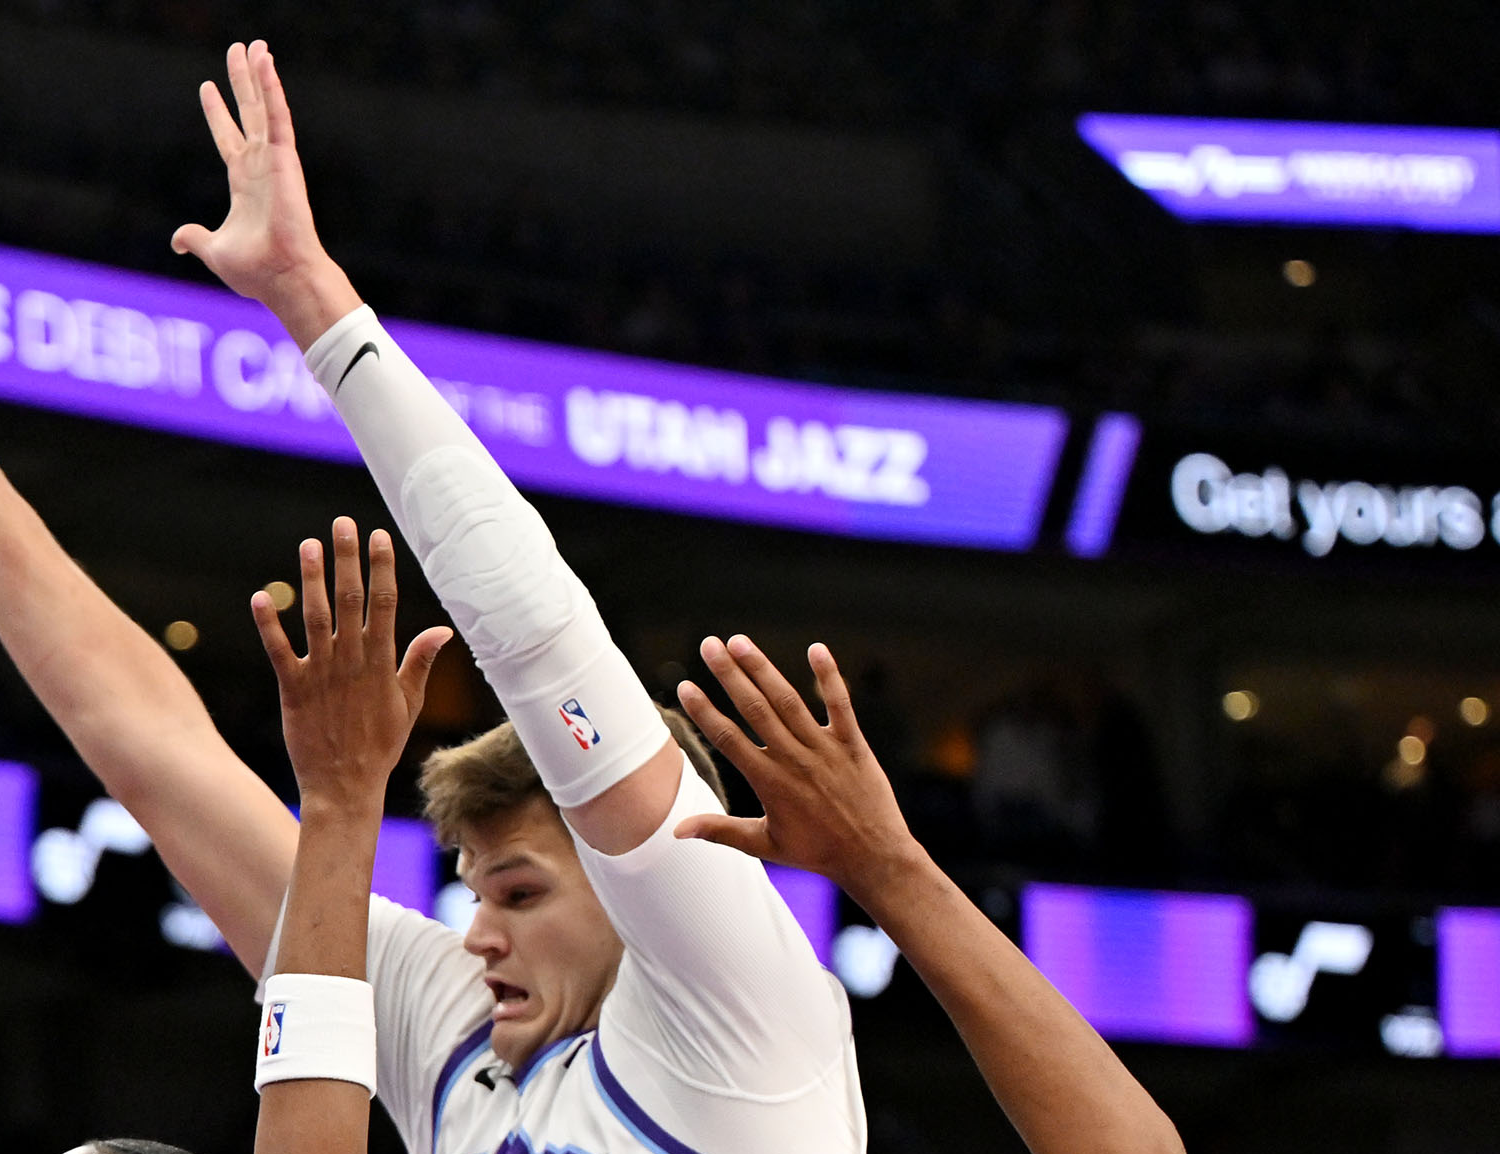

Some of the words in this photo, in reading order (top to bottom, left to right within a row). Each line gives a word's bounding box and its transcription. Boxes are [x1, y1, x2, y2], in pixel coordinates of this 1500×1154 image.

[15, 288, 214, 397] DEBIT
[565, 384, 750, 486] UTAH
[752, 415, 931, 507] JAZZ
[1170, 452, 1297, 541] Get
[1297, 479, 1485, 558] yours
